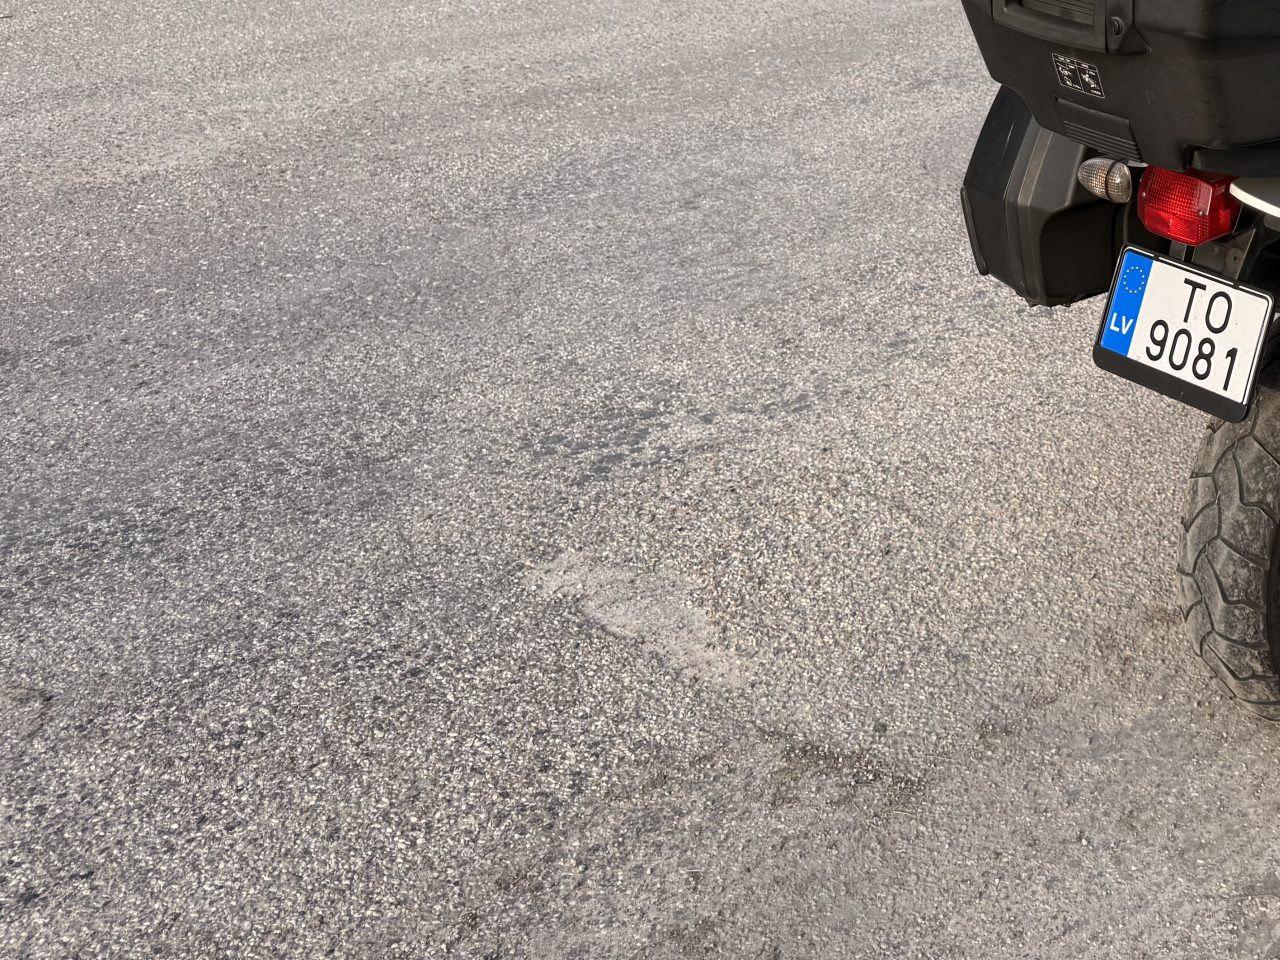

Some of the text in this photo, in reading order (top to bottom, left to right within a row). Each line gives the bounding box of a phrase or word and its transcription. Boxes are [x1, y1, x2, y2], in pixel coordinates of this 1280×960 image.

[1110, 313, 1134, 335] LV
[1184, 277, 1233, 334] TO
[1146, 319, 1239, 392] 9081
